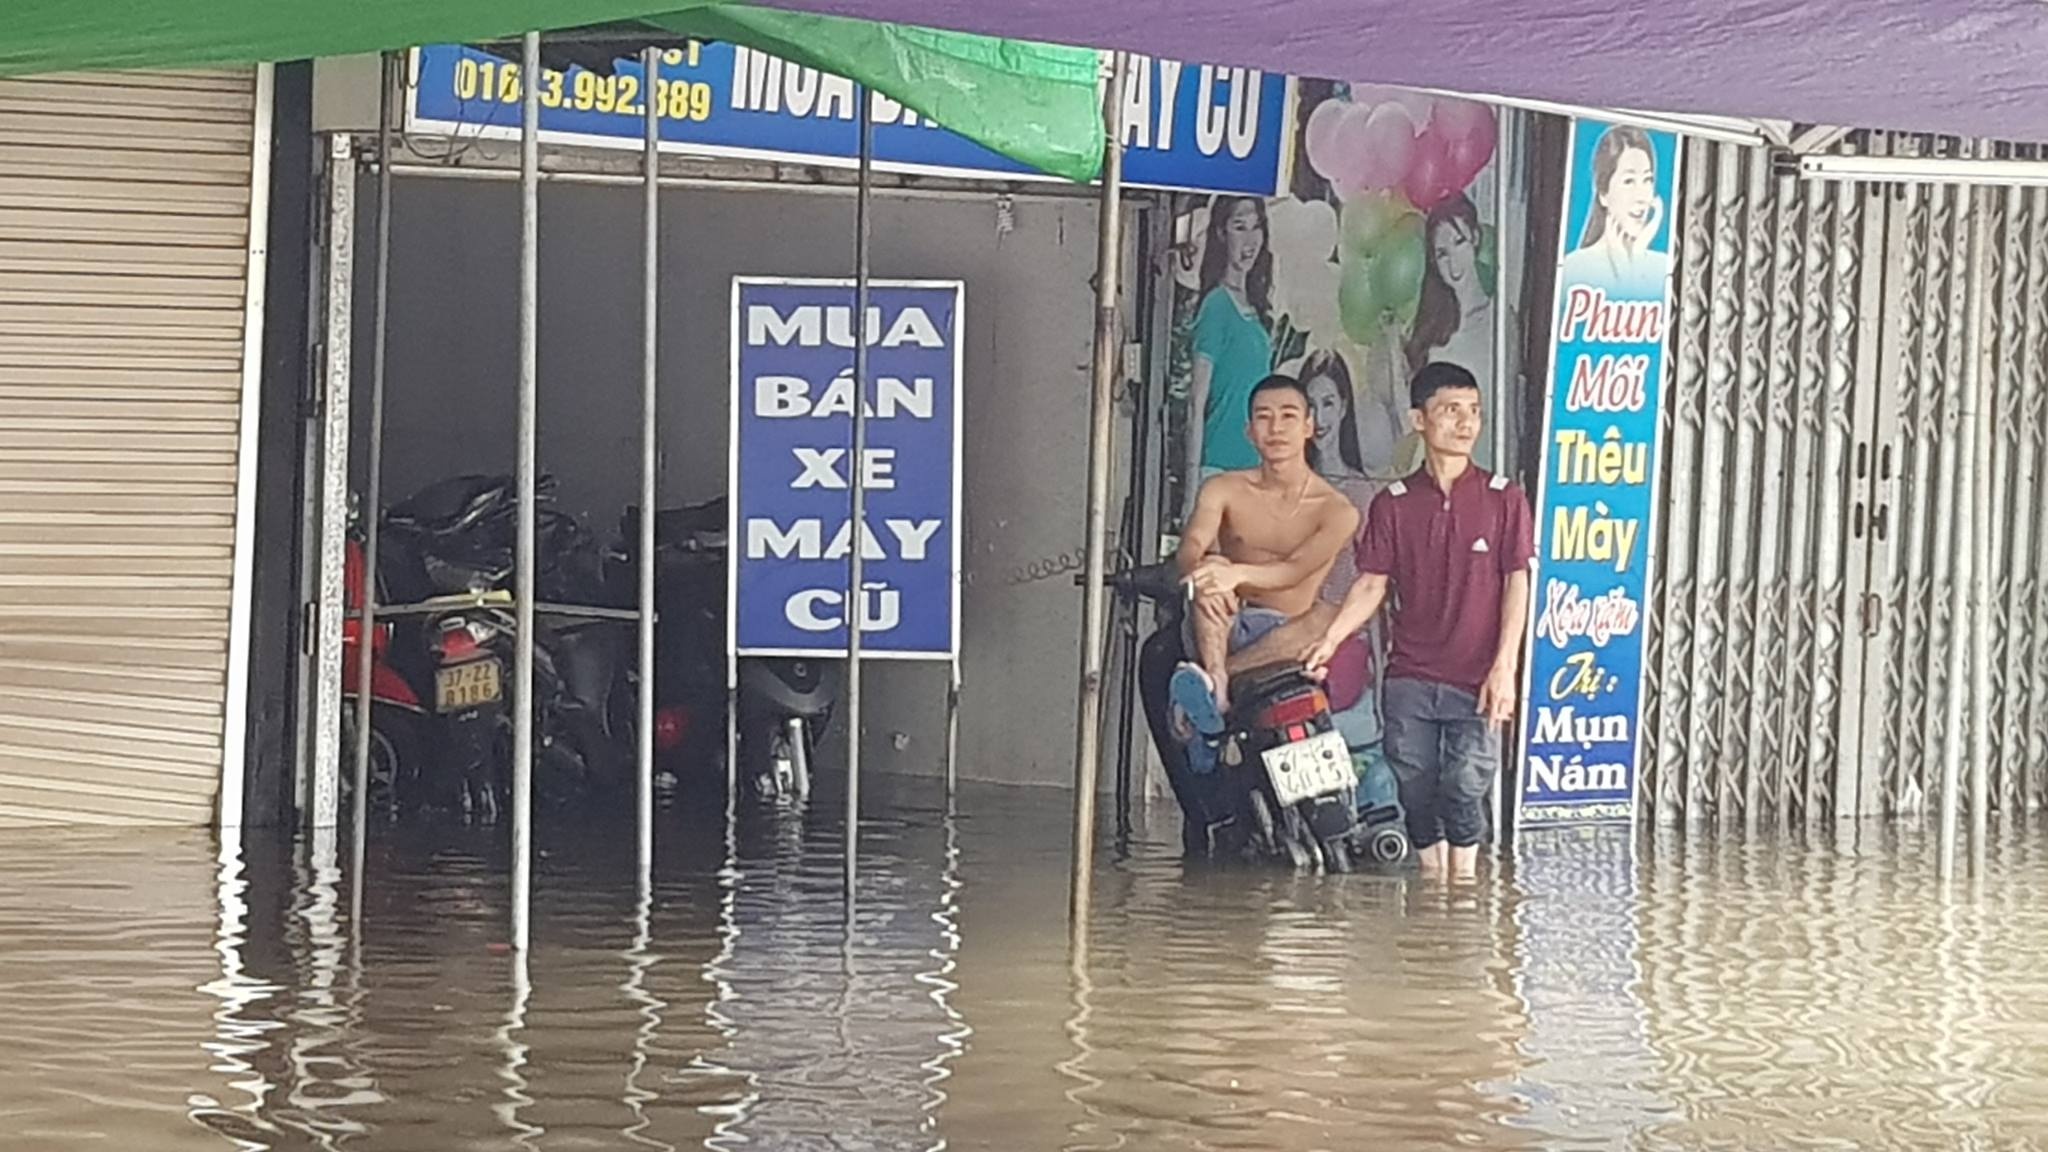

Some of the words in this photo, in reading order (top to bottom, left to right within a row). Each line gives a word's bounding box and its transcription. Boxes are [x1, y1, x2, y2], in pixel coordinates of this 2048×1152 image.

[454, 59, 711, 121] 0163.992.389
[746, 305, 945, 348] MUA
[1560, 284, 1663, 343] Phun
[754, 368, 934, 418] BÁN
[1565, 353, 1650, 412] Môi
[790, 448, 896, 489] XE
[1555, 425, 1647, 485] Thêu
[747, 510, 942, 560] MÁY
[1551, 500, 1638, 572] Mày
[785, 583, 901, 631] CŨ
[1531, 706, 1628, 750] Mụn
[1526, 755, 1627, 792] Nám
